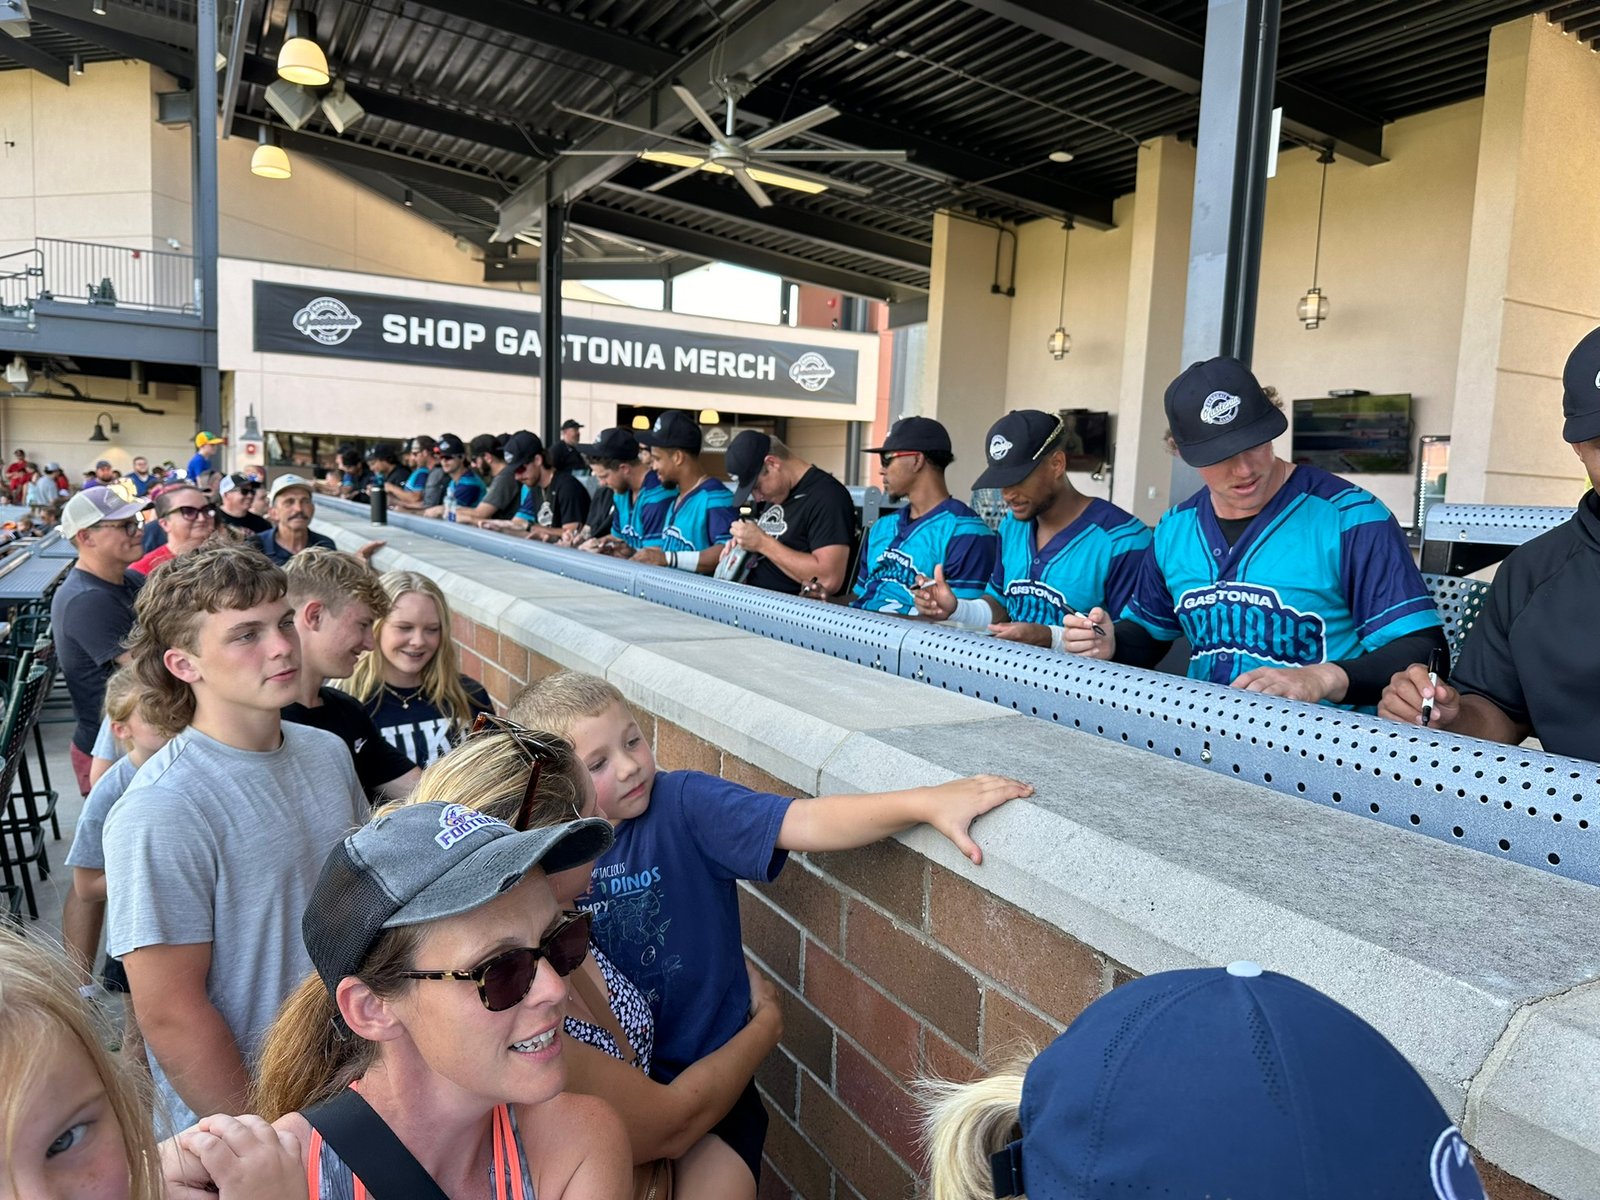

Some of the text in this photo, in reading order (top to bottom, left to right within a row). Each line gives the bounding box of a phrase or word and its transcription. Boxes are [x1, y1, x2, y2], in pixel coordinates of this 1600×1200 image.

[382, 314, 776, 381] SHOP GATONIA MERCH
[1010, 586, 1061, 607] GASTONIA
[1183, 590, 1274, 609] GASTONIA
[439, 816, 500, 846] FOOTBA
[611, 866, 662, 895] DINOS
[577, 900, 609, 914] MPY
